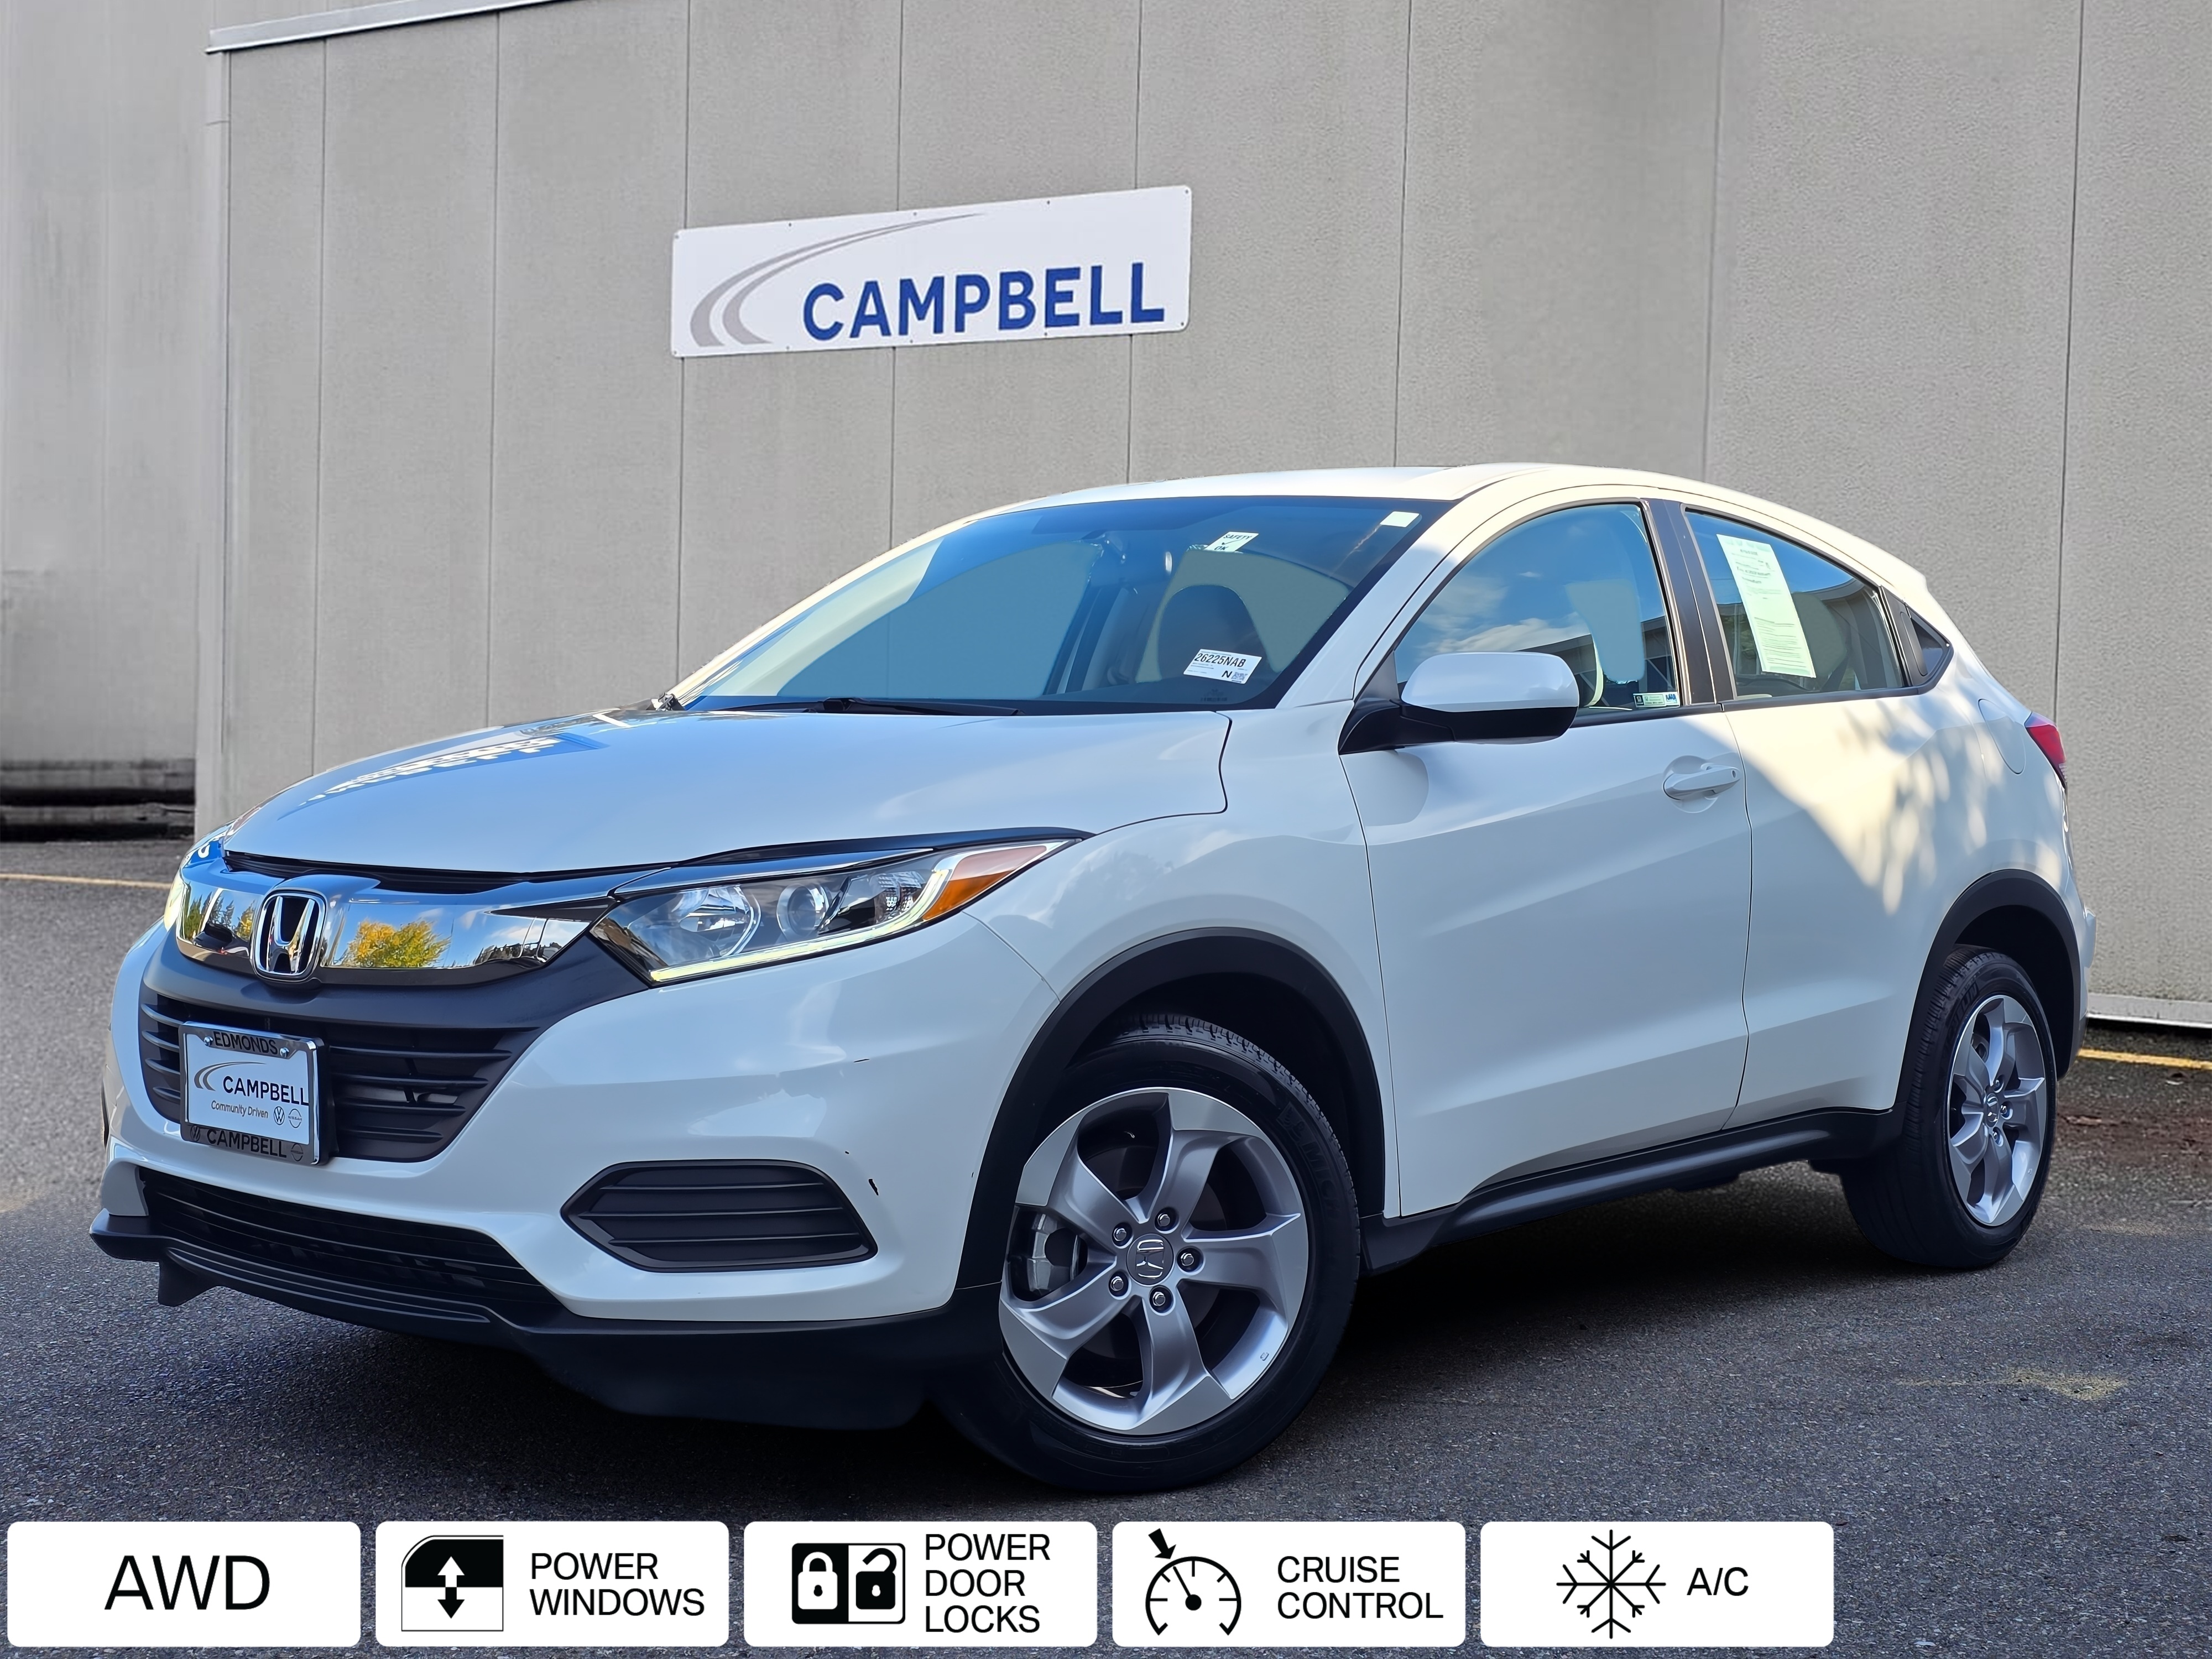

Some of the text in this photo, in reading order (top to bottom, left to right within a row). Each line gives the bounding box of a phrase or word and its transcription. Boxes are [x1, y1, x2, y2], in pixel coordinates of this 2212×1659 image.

[804, 262, 1165, 340] CAMPBELL
[1194, 653, 1246, 667] 26225NAB
[213, 1031, 278, 1055] EDMONDS
[223, 1076, 309, 1106] CAMPBELL
[211, 1100, 268, 1118] Community Driven
[207, 1129, 287, 1158] CAMPBELL
